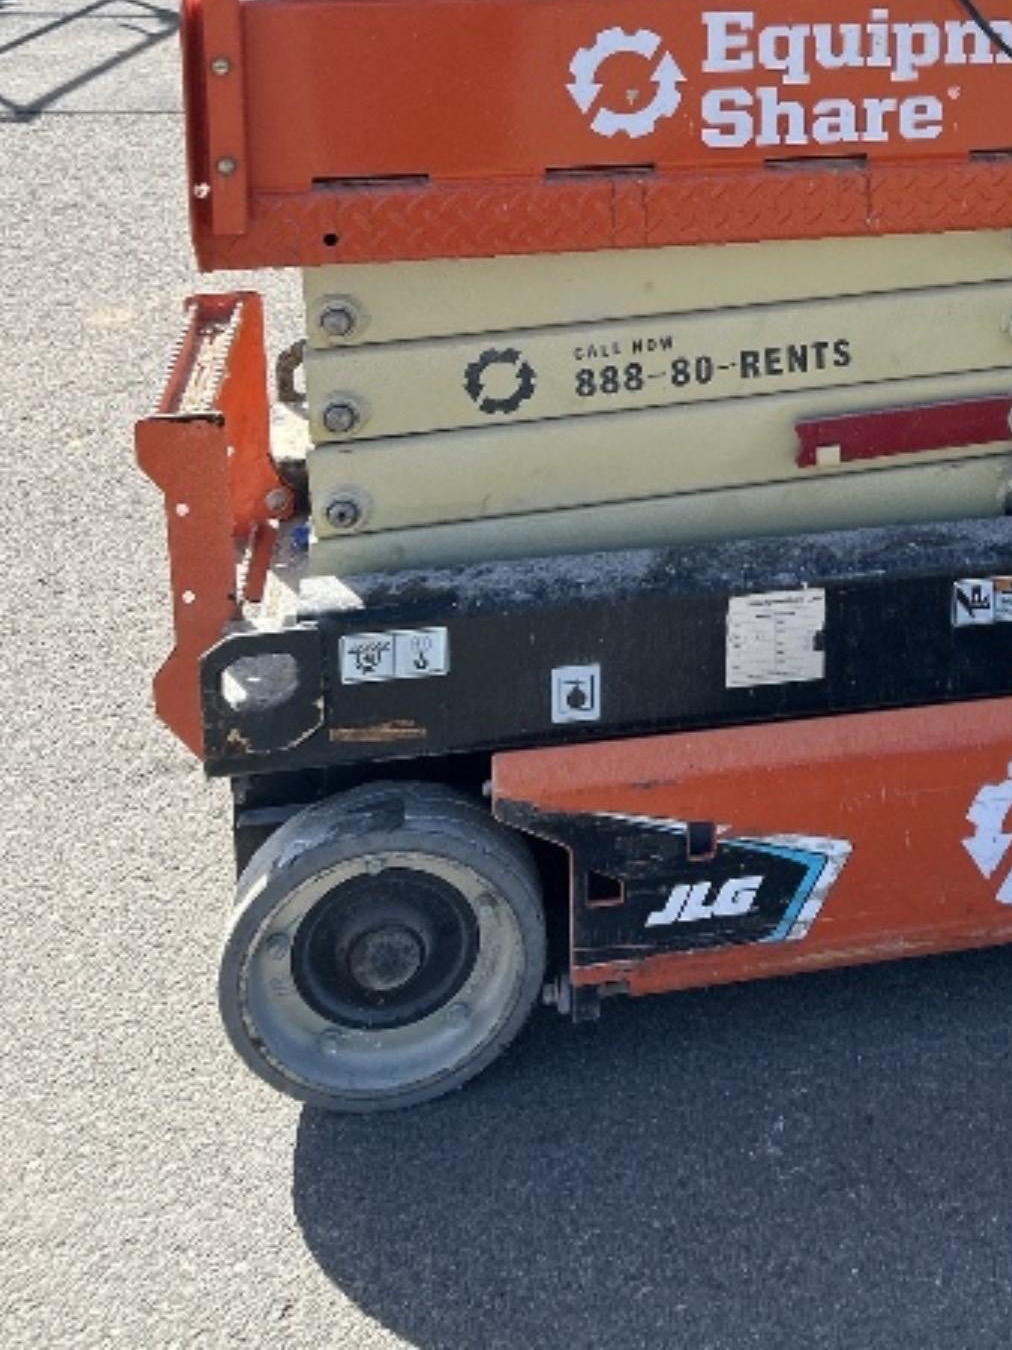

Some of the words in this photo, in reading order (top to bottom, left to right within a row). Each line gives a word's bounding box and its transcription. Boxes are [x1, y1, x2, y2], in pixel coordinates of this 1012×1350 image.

[700, 86, 943, 148] Share
[573, 341, 621, 361] CALL
[575, 338, 853, 397] 888-80-RENTS
[643, 874, 765, 928] JLG
